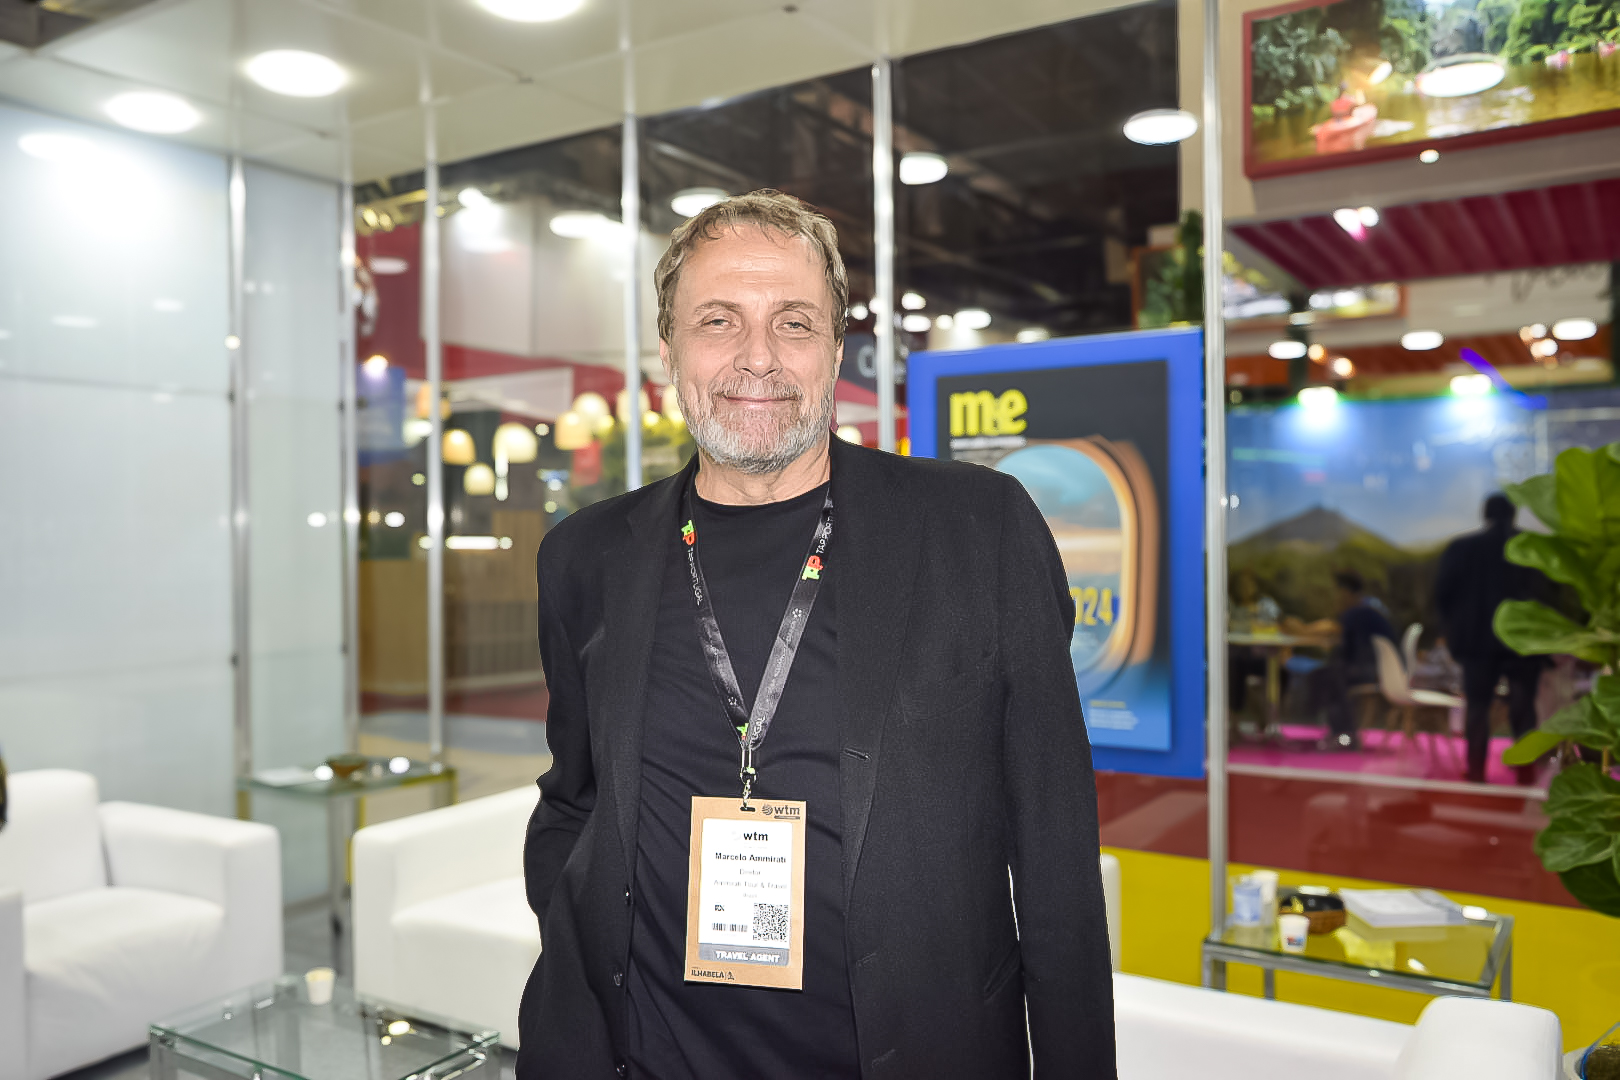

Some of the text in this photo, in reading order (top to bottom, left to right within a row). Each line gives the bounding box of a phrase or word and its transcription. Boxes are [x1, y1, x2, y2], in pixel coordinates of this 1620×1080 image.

[774, 805, 800, 816] wtm
[743, 831, 769, 841] wtm
[715, 852, 747, 861] Marcelo
[715, 950, 781, 963] TRAVEL AGENT
[691, 969, 725, 979] ILHABELA
